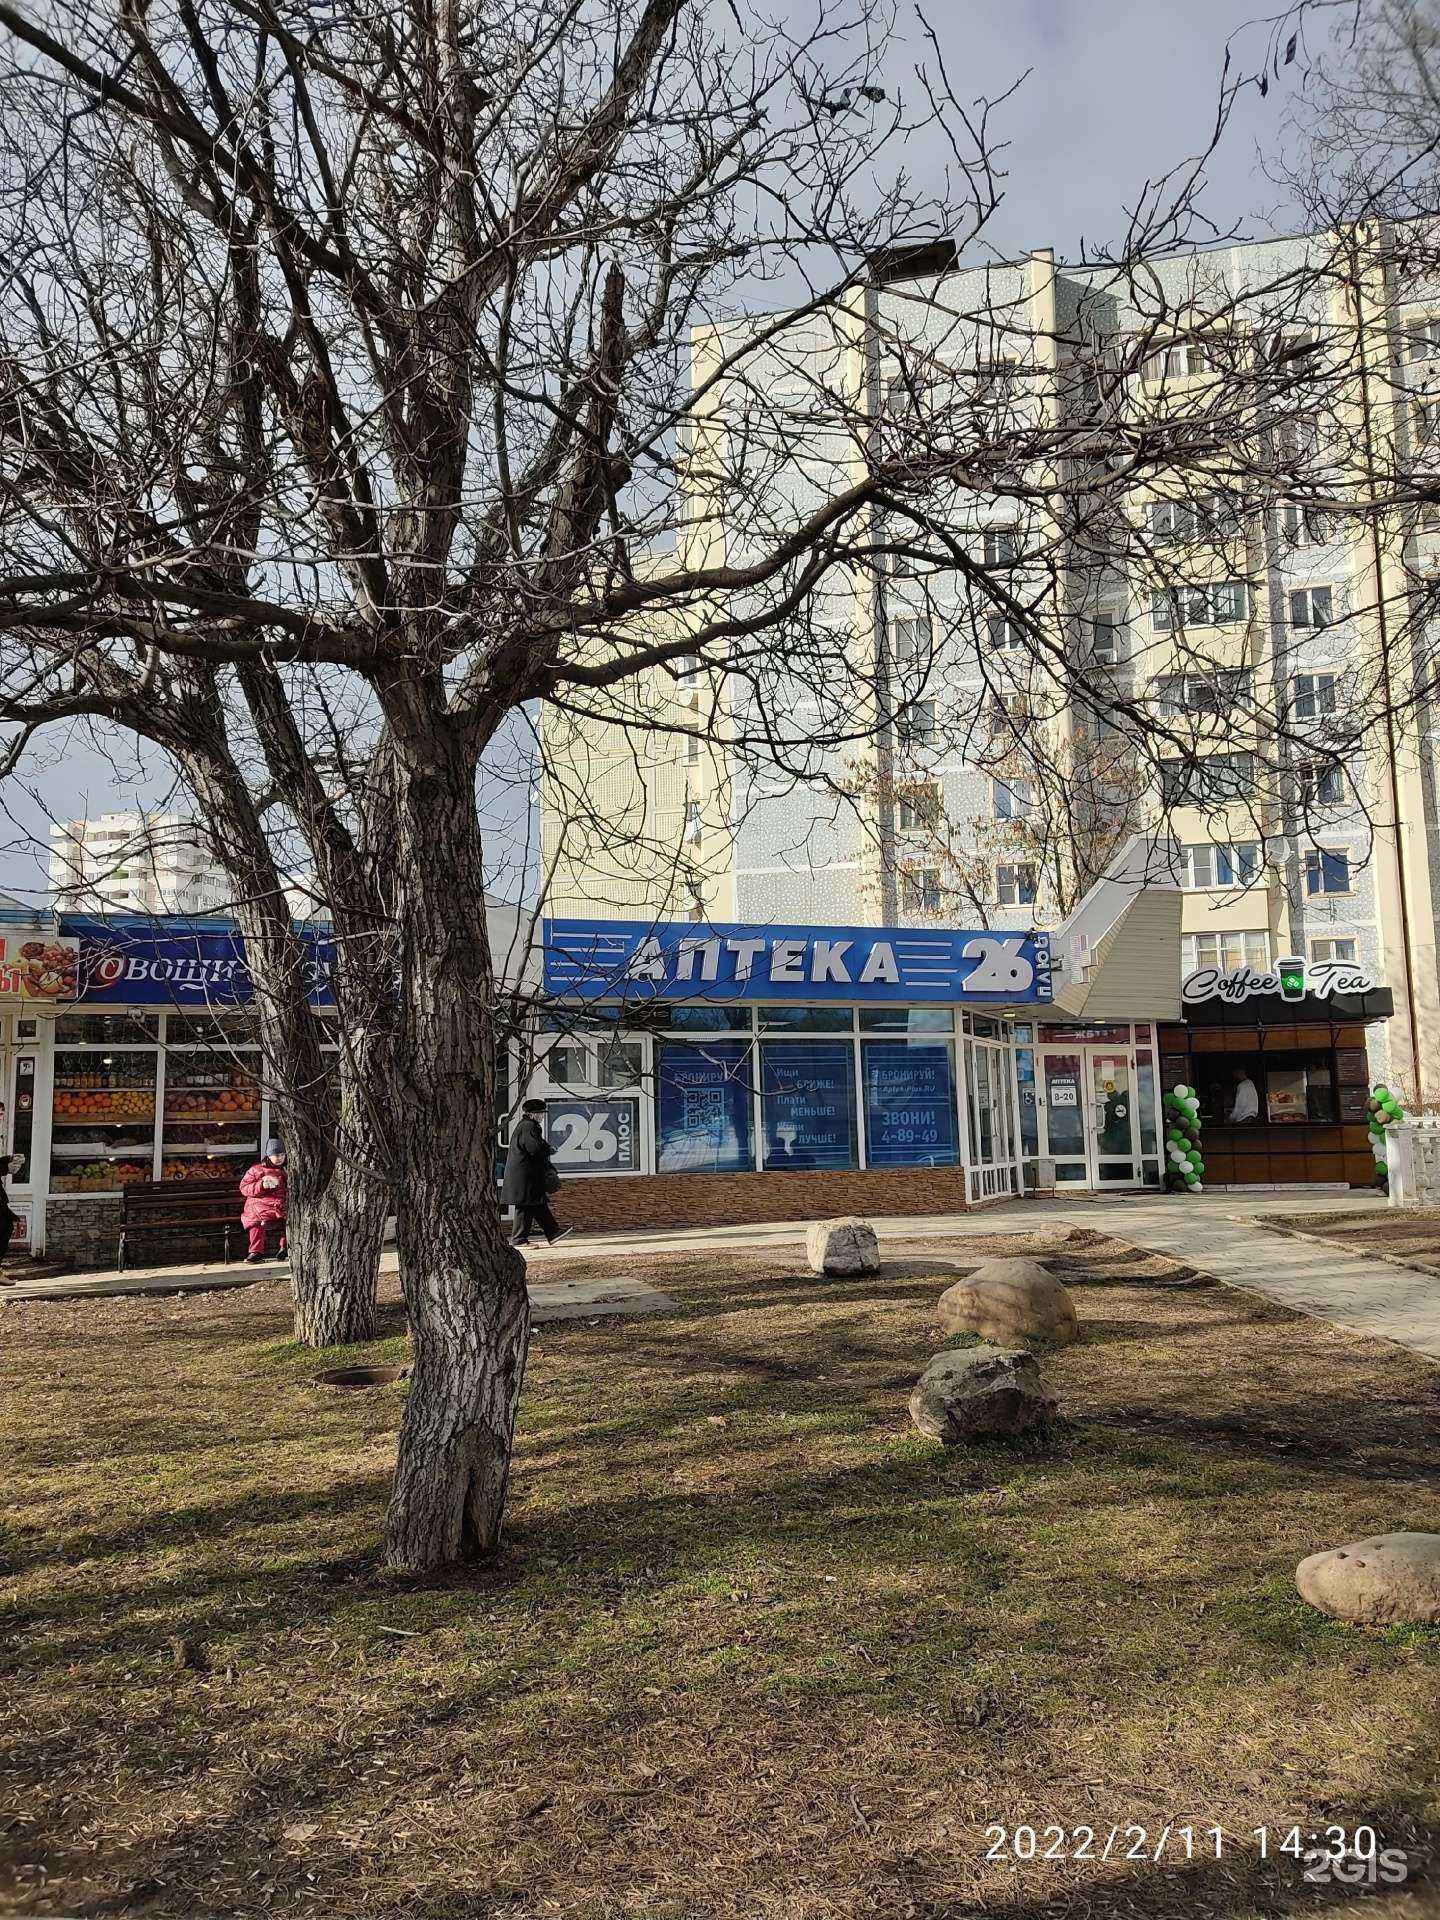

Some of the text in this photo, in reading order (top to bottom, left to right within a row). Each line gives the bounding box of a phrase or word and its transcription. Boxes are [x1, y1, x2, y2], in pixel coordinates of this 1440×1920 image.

[624, 936, 900, 983] АПТЕКА
[962, 937, 1034, 992] 26
[1183, 963, 1370, 998] Coffee Tea
[881, 1068, 936, 1080] БРОНИРУЙ!
[790, 1106, 836, 1117] МЕНЬШЕ!
[881, 1110, 936, 1126] ЗВОНИ!
[551, 1112, 631, 1163] 26 ПЛЮС
[799, 1133, 837, 1144] ЛУЧШЕ!
[880, 1128, 938, 1144] 4-89-49
